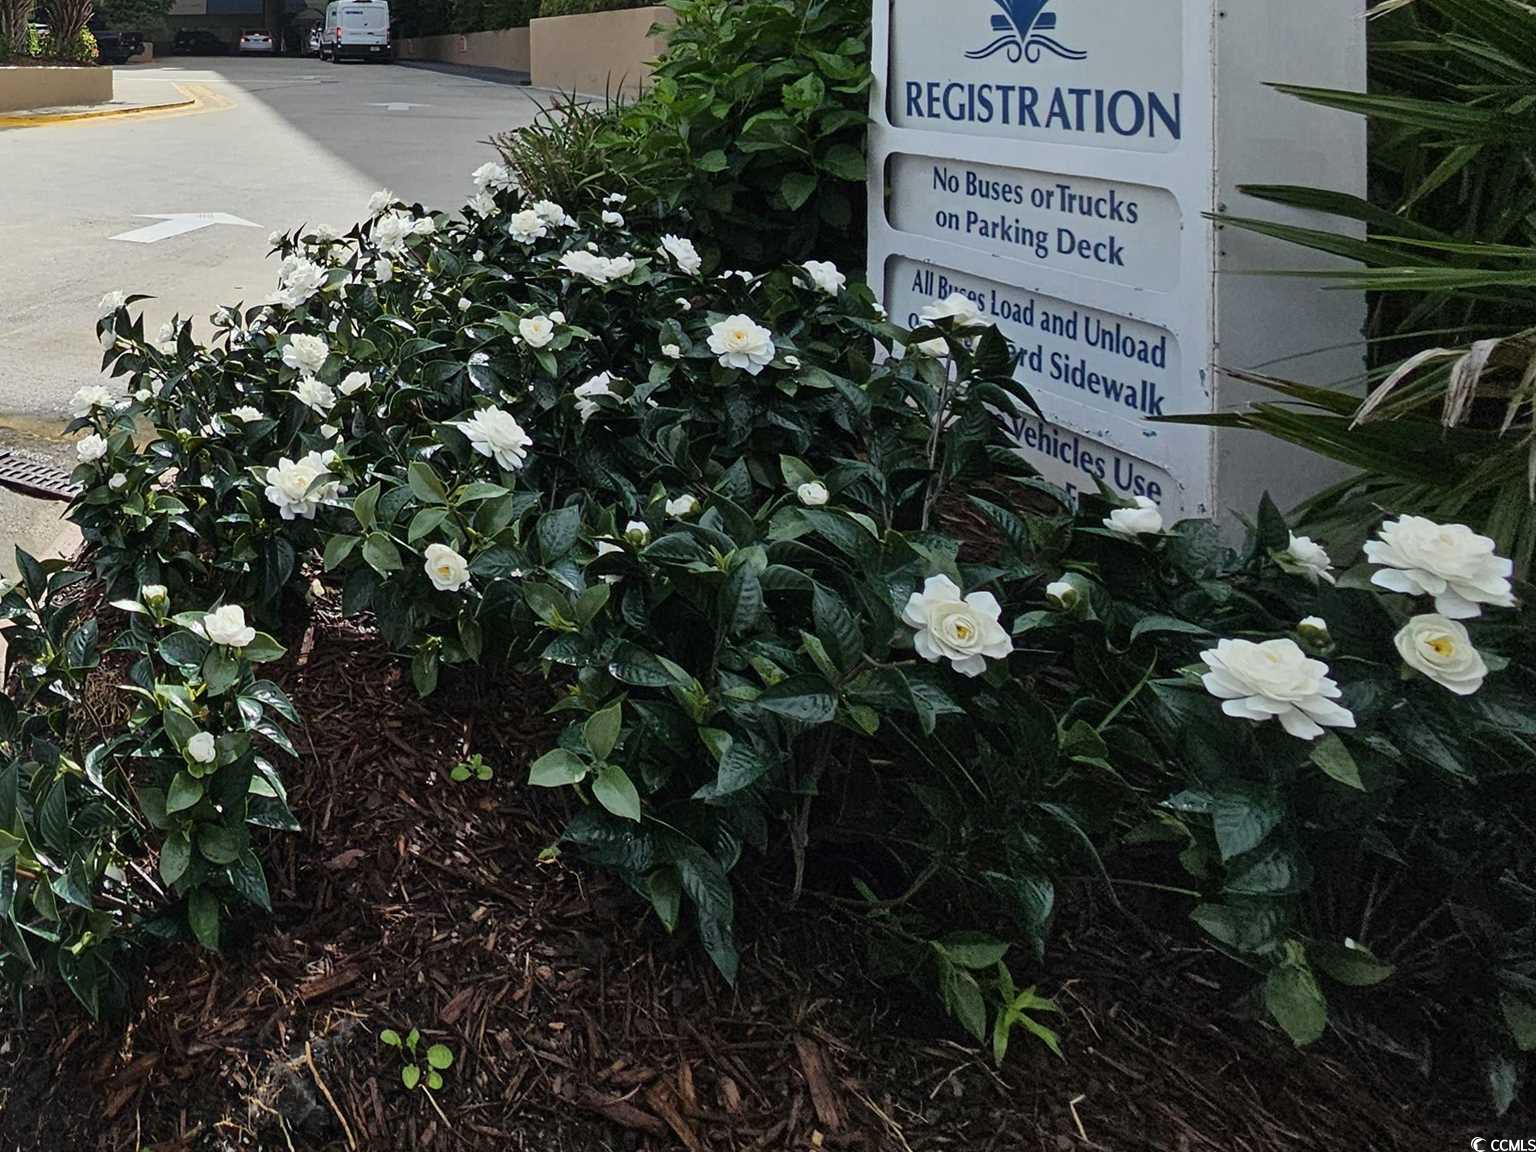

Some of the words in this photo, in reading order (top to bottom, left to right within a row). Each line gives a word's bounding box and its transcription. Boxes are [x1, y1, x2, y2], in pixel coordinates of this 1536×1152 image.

[905, 80, 1182, 140] REGISTRATION
[933, 166, 959, 193] No
[966, 171, 1024, 205] Buses
[1030, 188, 1054, 210] or
[1056, 184, 1139, 224] Trucks
[936, 209, 960, 231] on
[966, 210, 1049, 259] Parking
[1057, 227, 1125, 266] Deck
[912, 269, 934, 296] All
[991, 290, 1035, 327] Load
[1040, 310, 1077, 340] and
[1084, 316, 1167, 369] Unload
[1050, 351, 1166, 416] Sidewalk
[1014, 417, 1107, 479] Vehicles
[1114, 457, 1163, 505] Use
